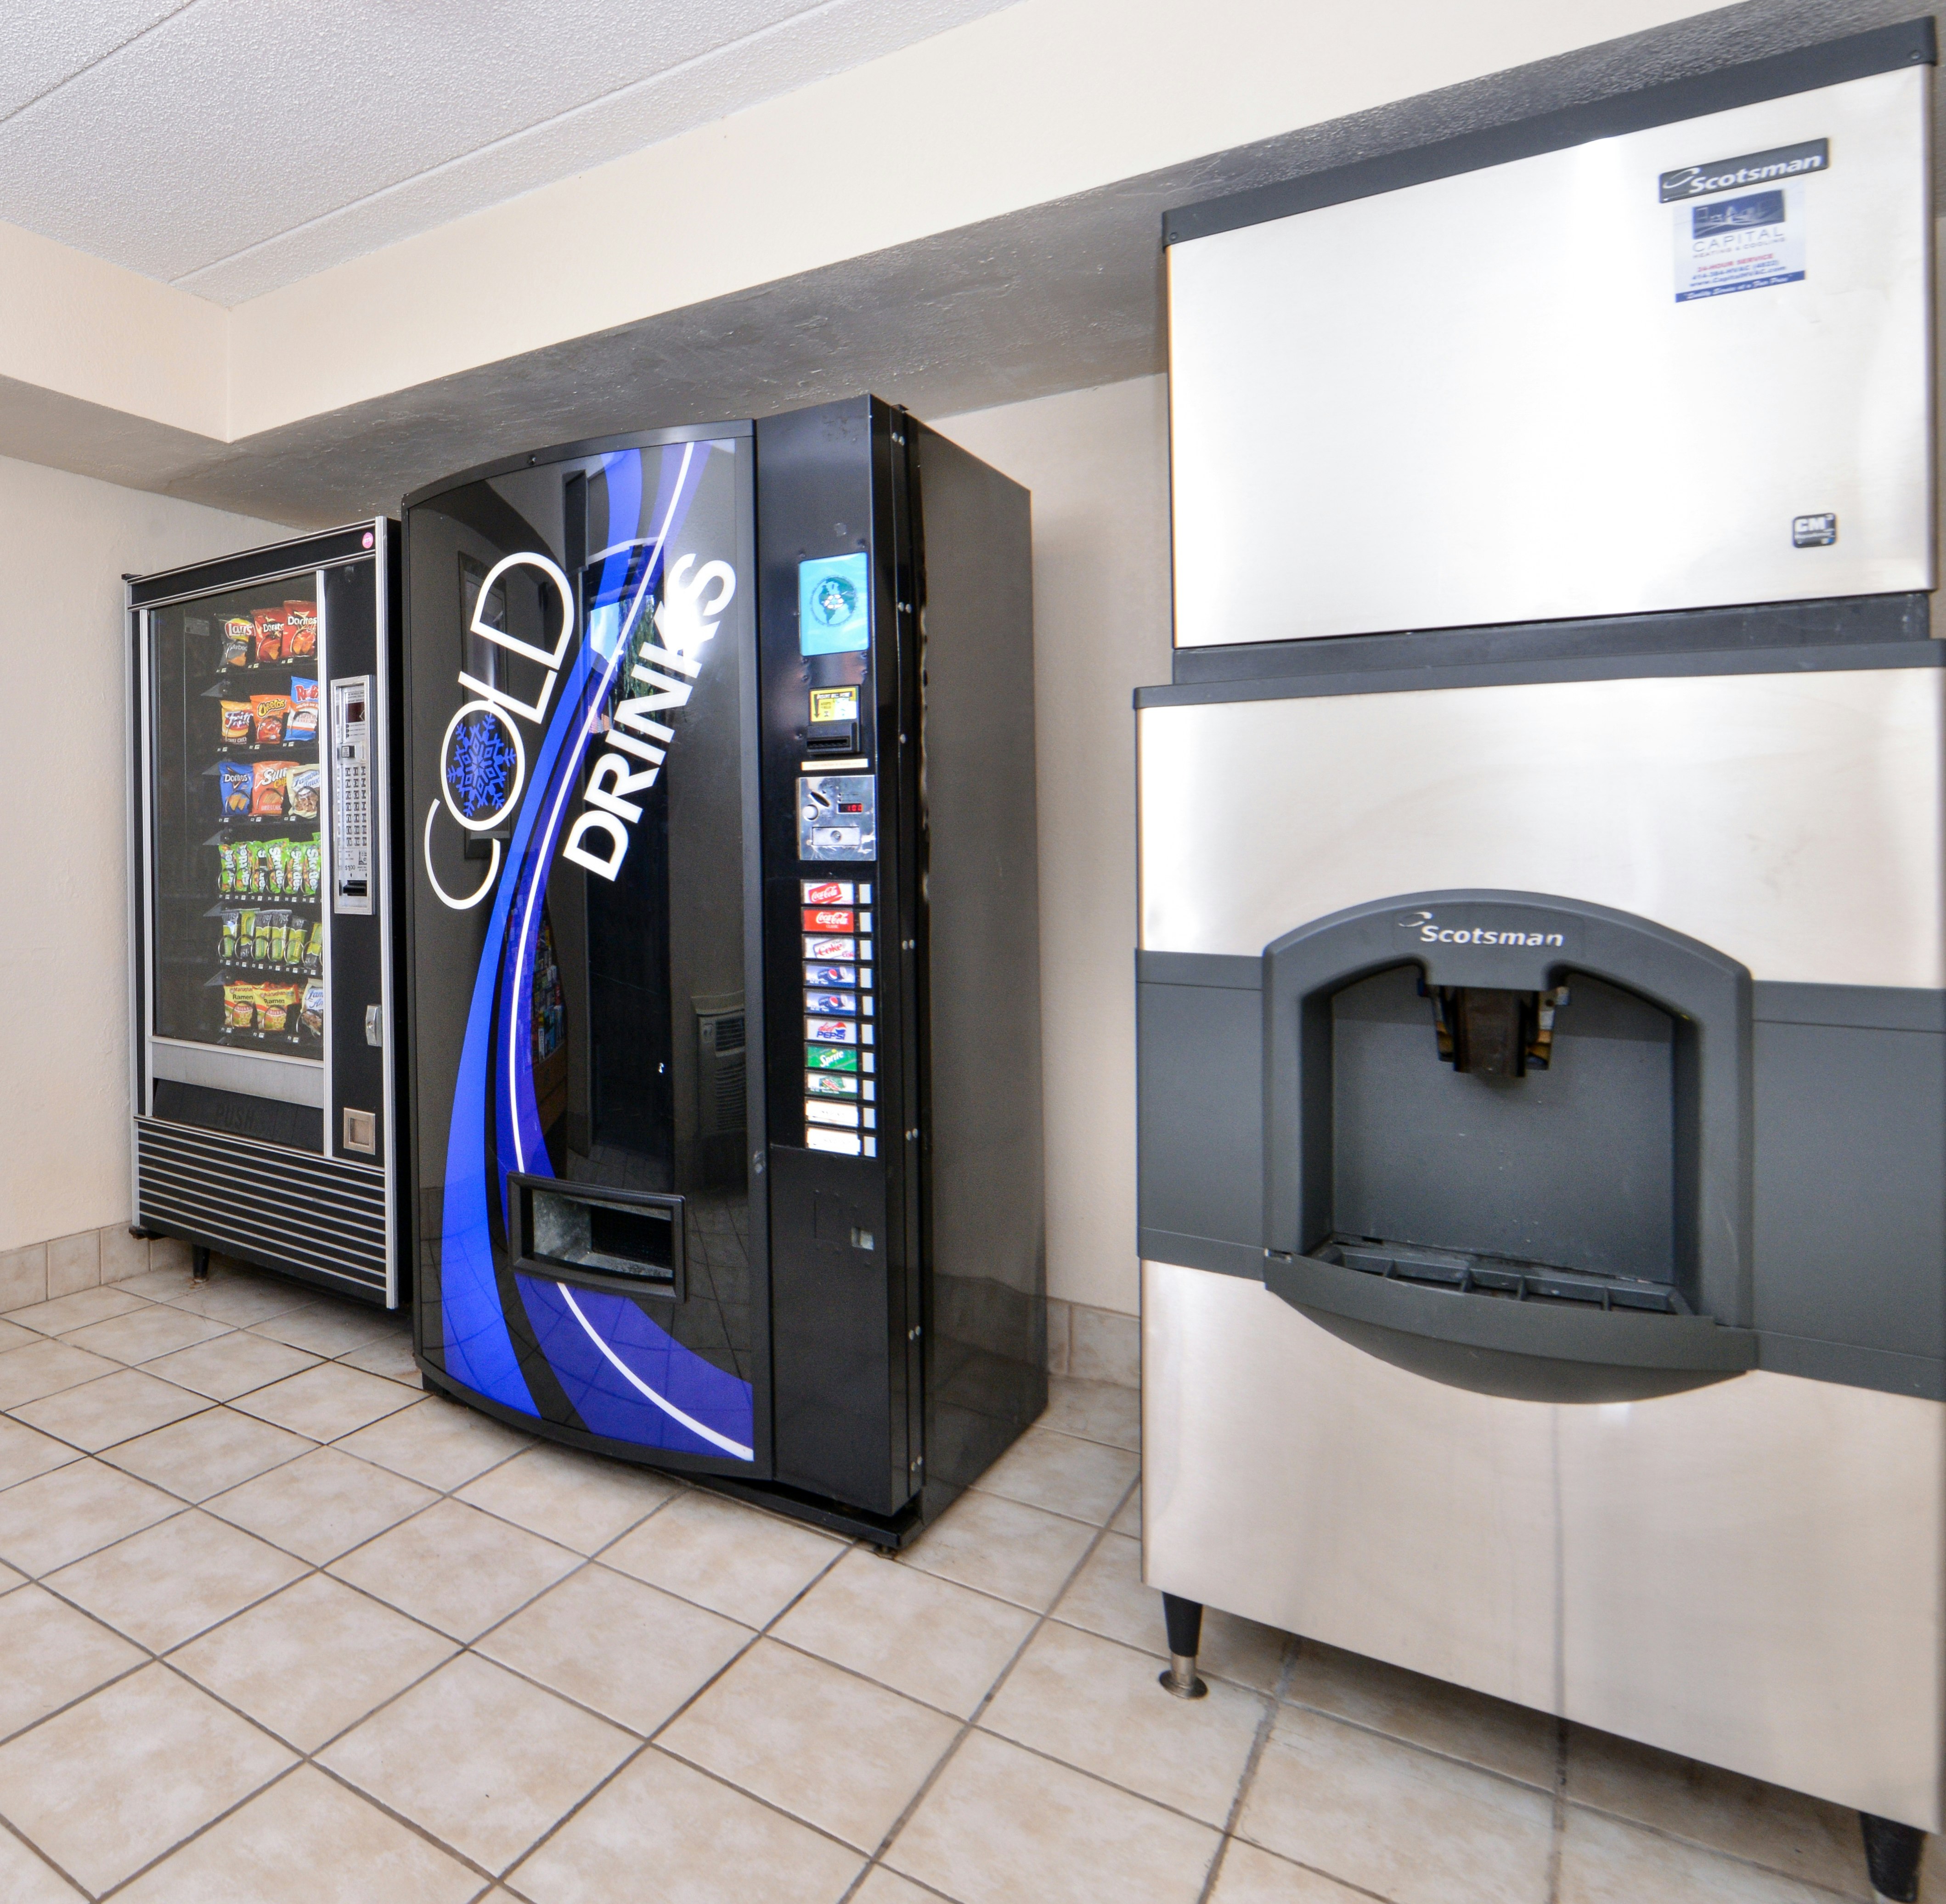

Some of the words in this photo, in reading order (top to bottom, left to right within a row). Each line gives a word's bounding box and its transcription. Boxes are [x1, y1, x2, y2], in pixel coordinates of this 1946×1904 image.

[1689, 154, 1823, 193] Scotsman
[1692, 227, 1784, 252] CAPITAL
[1693, 248, 1731, 258] HEATING
[1744, 237, 1785, 249] COOLING
[1737, 253, 1774, 265] SERVICE
[257, 699, 286, 717] Cheetos
[562, 553, 736, 882] DRINKS
[424, 552, 575, 910] COLD
[224, 774, 248, 783] Doritos
[1420, 925, 1564, 947] Scotsman
[818, 943, 843, 956] Coke
[816, 1031, 846, 1040] PEPSI
[820, 1051, 844, 1068] Sprite
